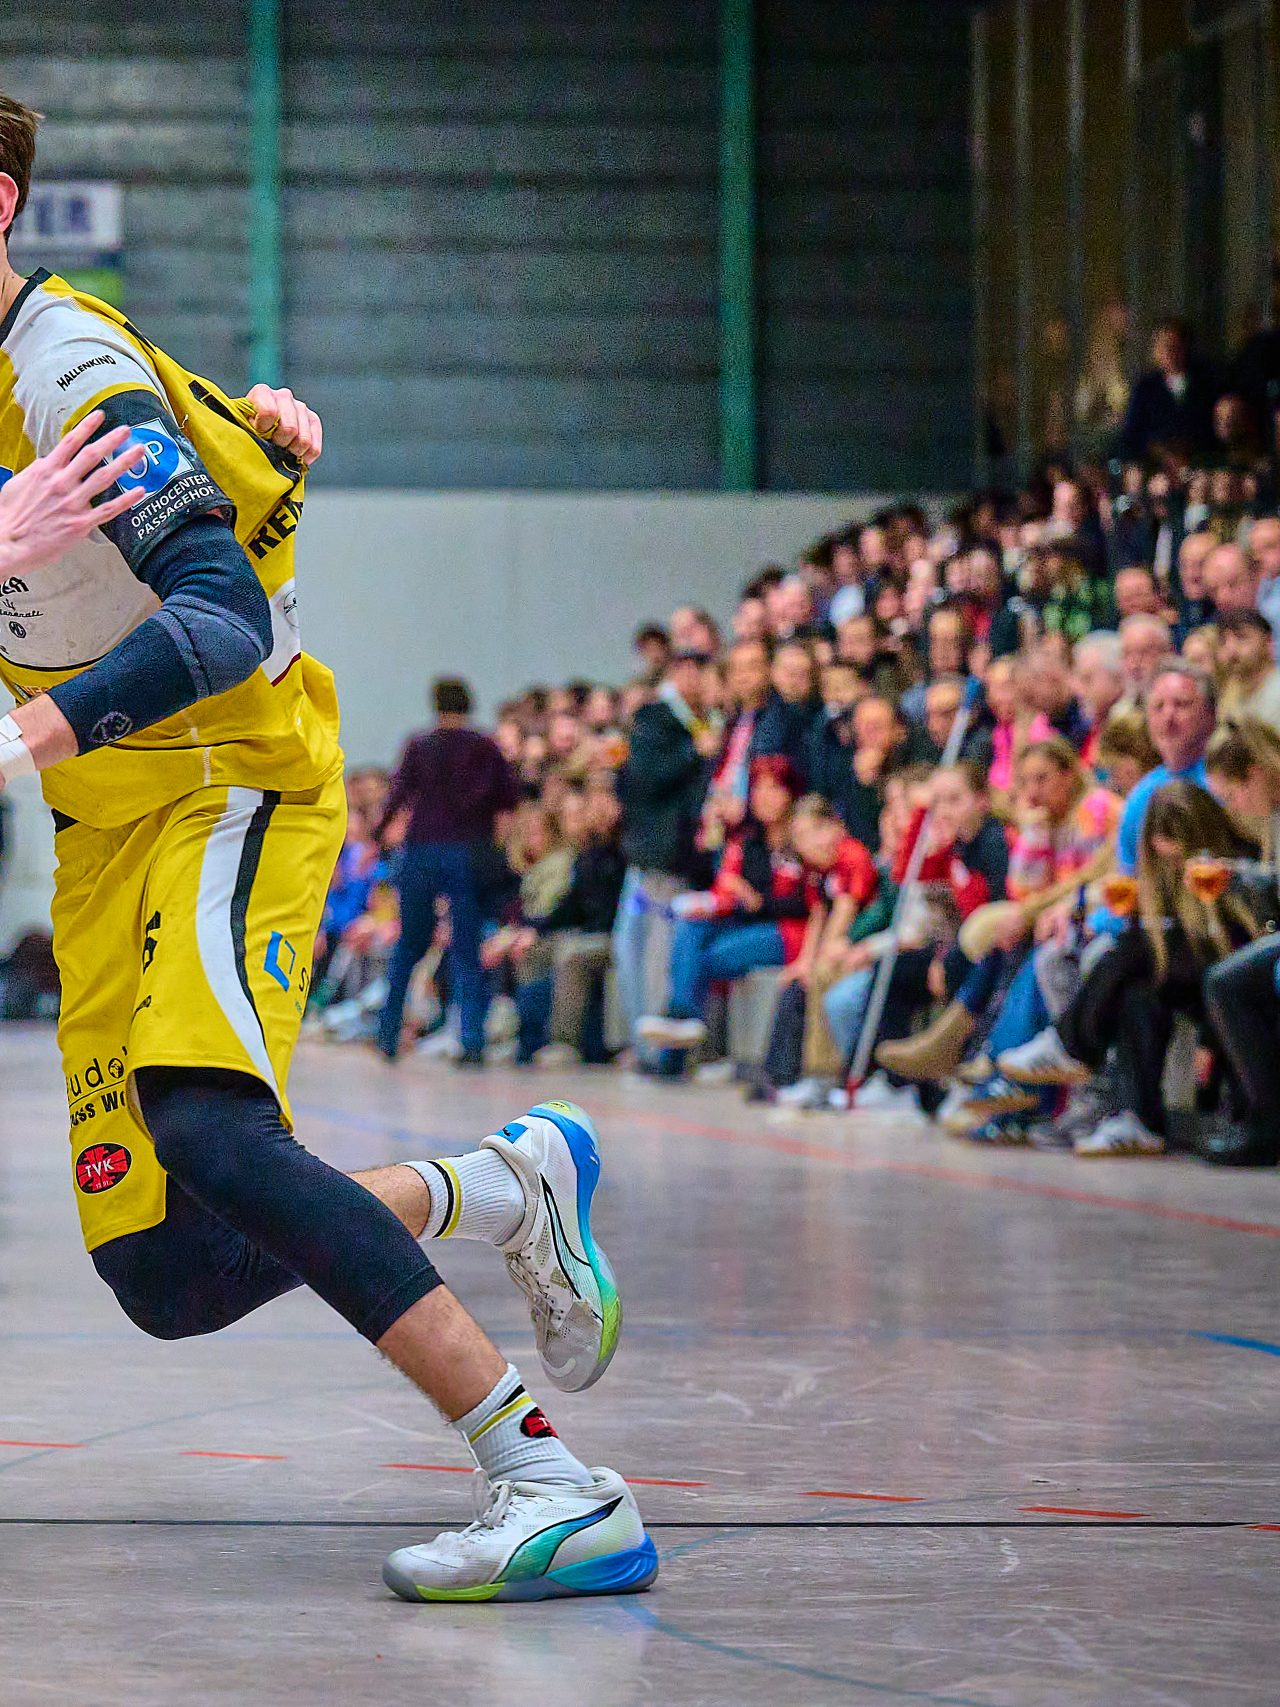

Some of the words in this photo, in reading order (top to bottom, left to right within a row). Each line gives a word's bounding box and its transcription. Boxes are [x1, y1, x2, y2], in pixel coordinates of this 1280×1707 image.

[56, 354, 117, 391] HALLENKIND
[131, 473, 211, 528] ORTHOCENTER
[137, 485, 216, 540] PASSAGEHOF
[84, 1158, 115, 1178] TVK
